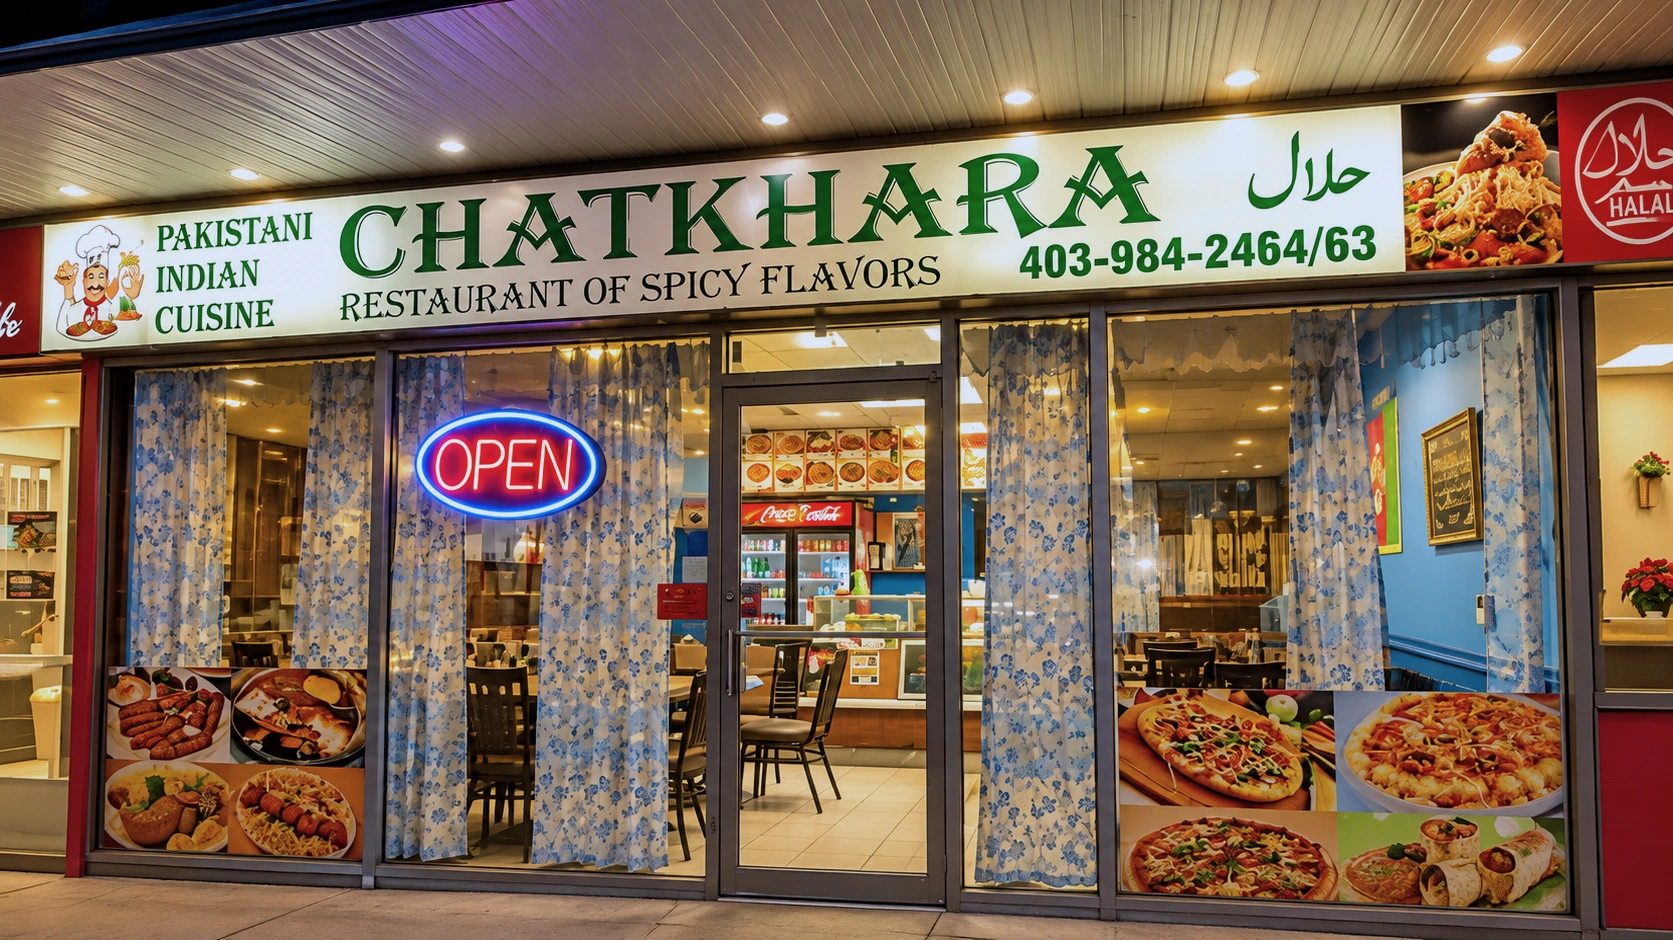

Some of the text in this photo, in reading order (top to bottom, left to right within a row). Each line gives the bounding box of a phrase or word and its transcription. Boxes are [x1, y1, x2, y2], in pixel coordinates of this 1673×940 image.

[1248, 130, 1371, 210] حلال
[156, 211, 313, 252] PAKISTANI
[339, 145, 1162, 279] CHATKHARA
[1610, 192, 1673, 218] HALAL
[156, 259, 260, 293] INDIAN
[1020, 225, 1377, 280] 403-984-2464/63
[340, 255, 941, 321] RESTAURANT OF SPICY FLAVORS
[155, 299, 275, 335] CUISINE
[435, 438, 574, 491] OPEN
